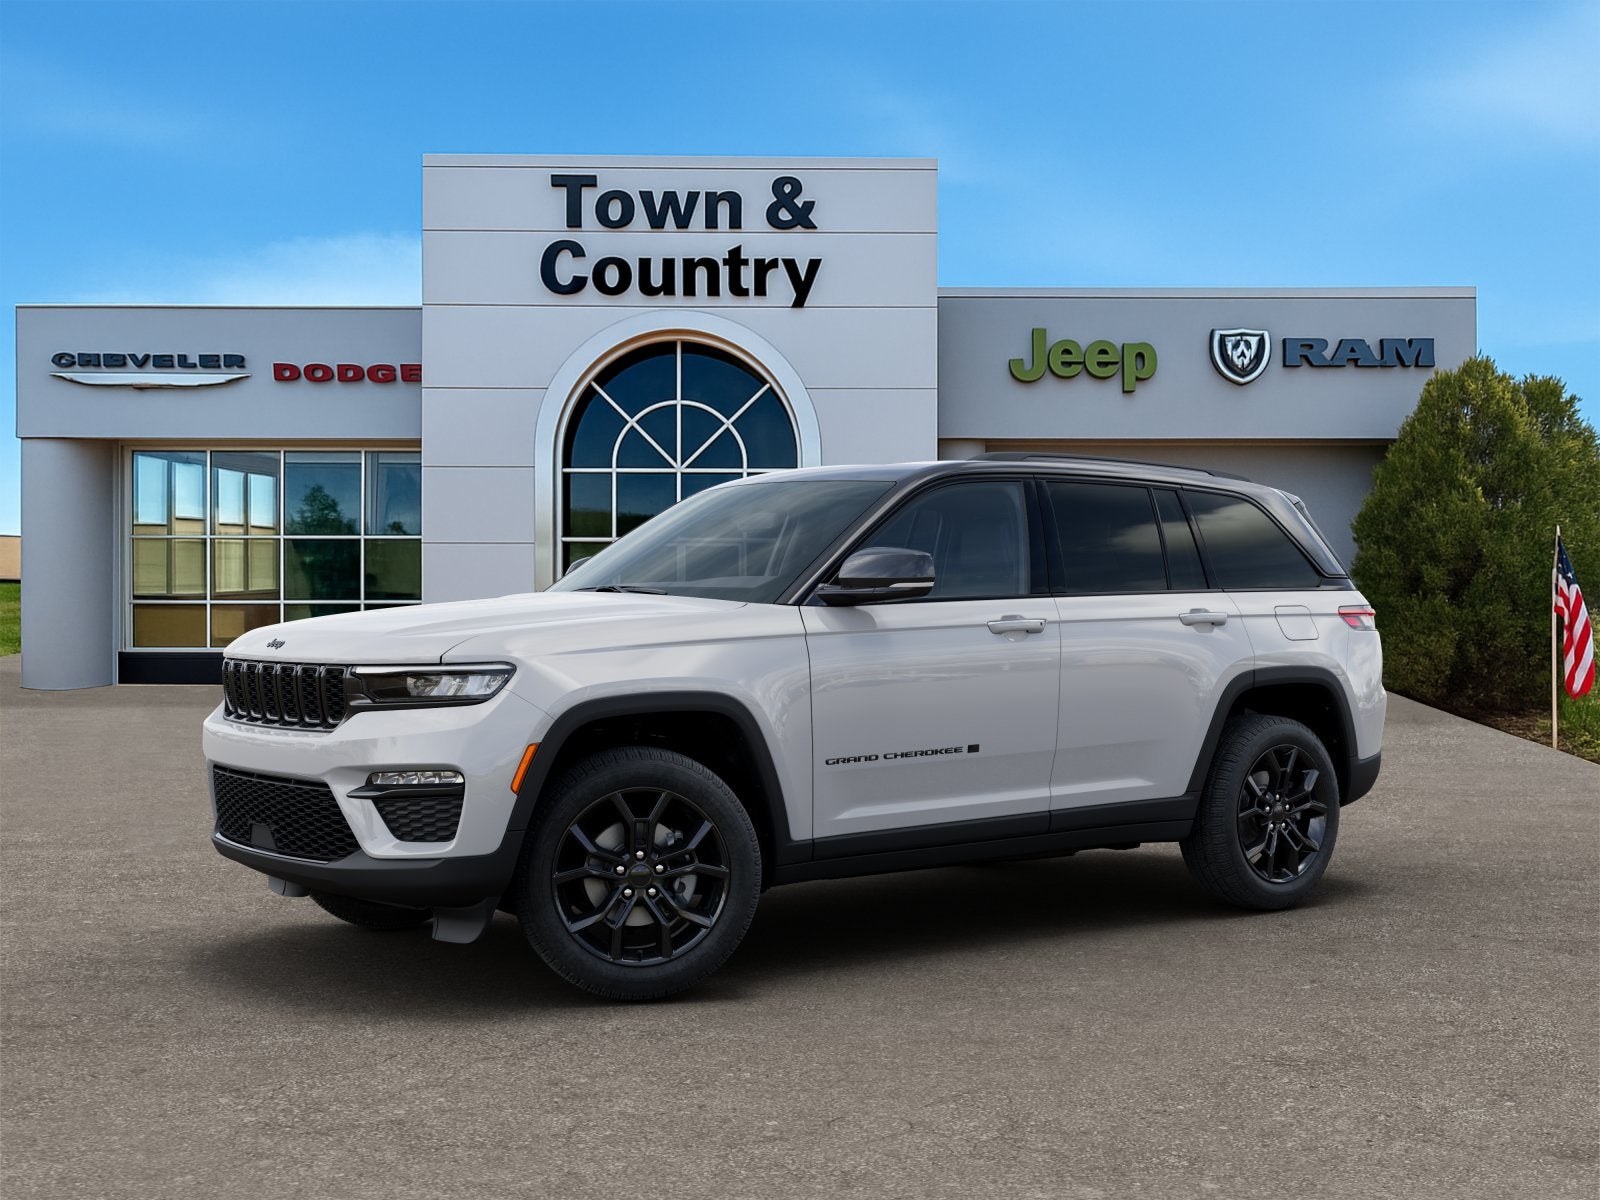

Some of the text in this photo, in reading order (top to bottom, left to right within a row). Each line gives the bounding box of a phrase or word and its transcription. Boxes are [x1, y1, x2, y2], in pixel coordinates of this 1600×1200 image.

[550, 174, 818, 230] Town &
[540, 239, 823, 308] Country
[273, 362, 421, 383] DODGE
[1008, 328, 1157, 393] Jeep
[1283, 337, 1435, 368] RAM
[825, 746, 964, 766] GRAND CHEROKEE
